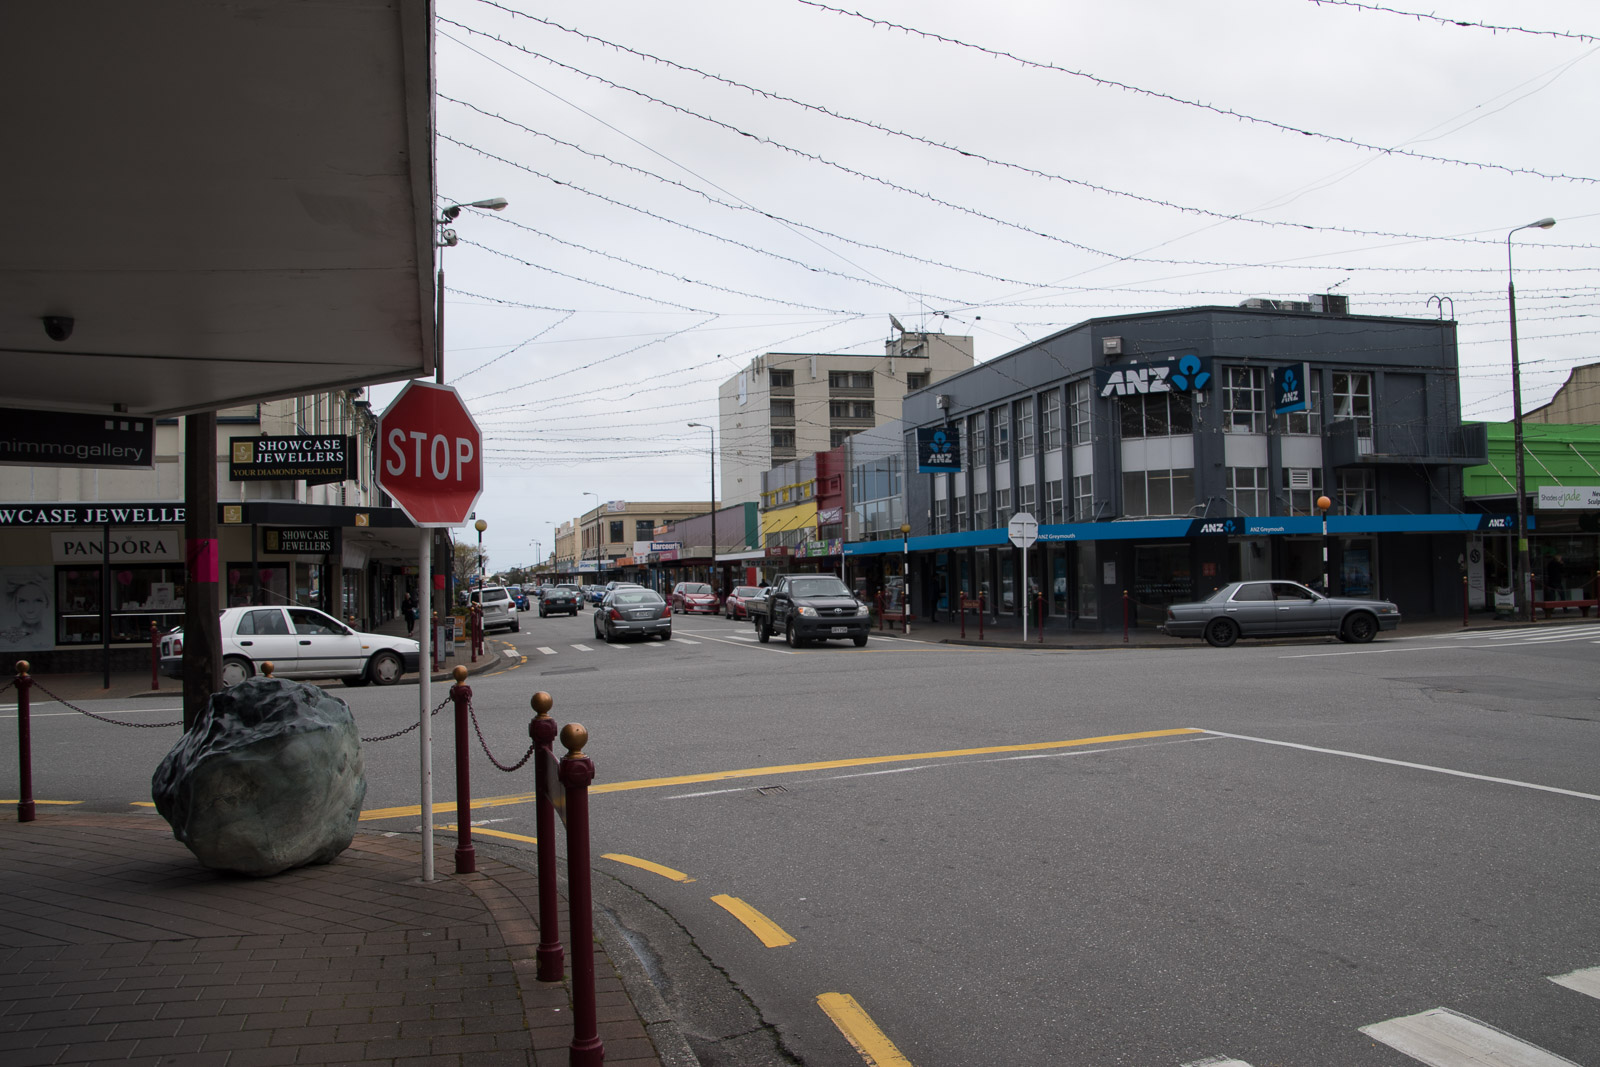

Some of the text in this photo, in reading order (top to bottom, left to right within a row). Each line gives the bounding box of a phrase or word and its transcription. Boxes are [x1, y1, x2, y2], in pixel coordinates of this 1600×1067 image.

[1101, 367, 1171, 397] ANZ
[1281, 391, 1298, 404] ANZ
[0, 437, 143, 461] nimmogallery
[258, 440, 341, 451] SHOWCASE
[256, 451, 344, 463] JEWELLERS
[386, 428, 474, 482] STOP
[927, 453, 952, 464] ANZ
[257, 468, 297, 476] DIAMOND
[297, 467, 343, 475] SPECIALIST
[84, 508, 185, 522] JEWELLE
[1200, 523, 1224, 533] ANZ
[1488, 518, 1505, 528] ANZ
[282, 530, 329, 540] SHOWCASE
[64, 540, 167, 555] PANDORA
[282, 541, 331, 551] JEWELLERS
[652, 542, 681, 550] Harcourts
